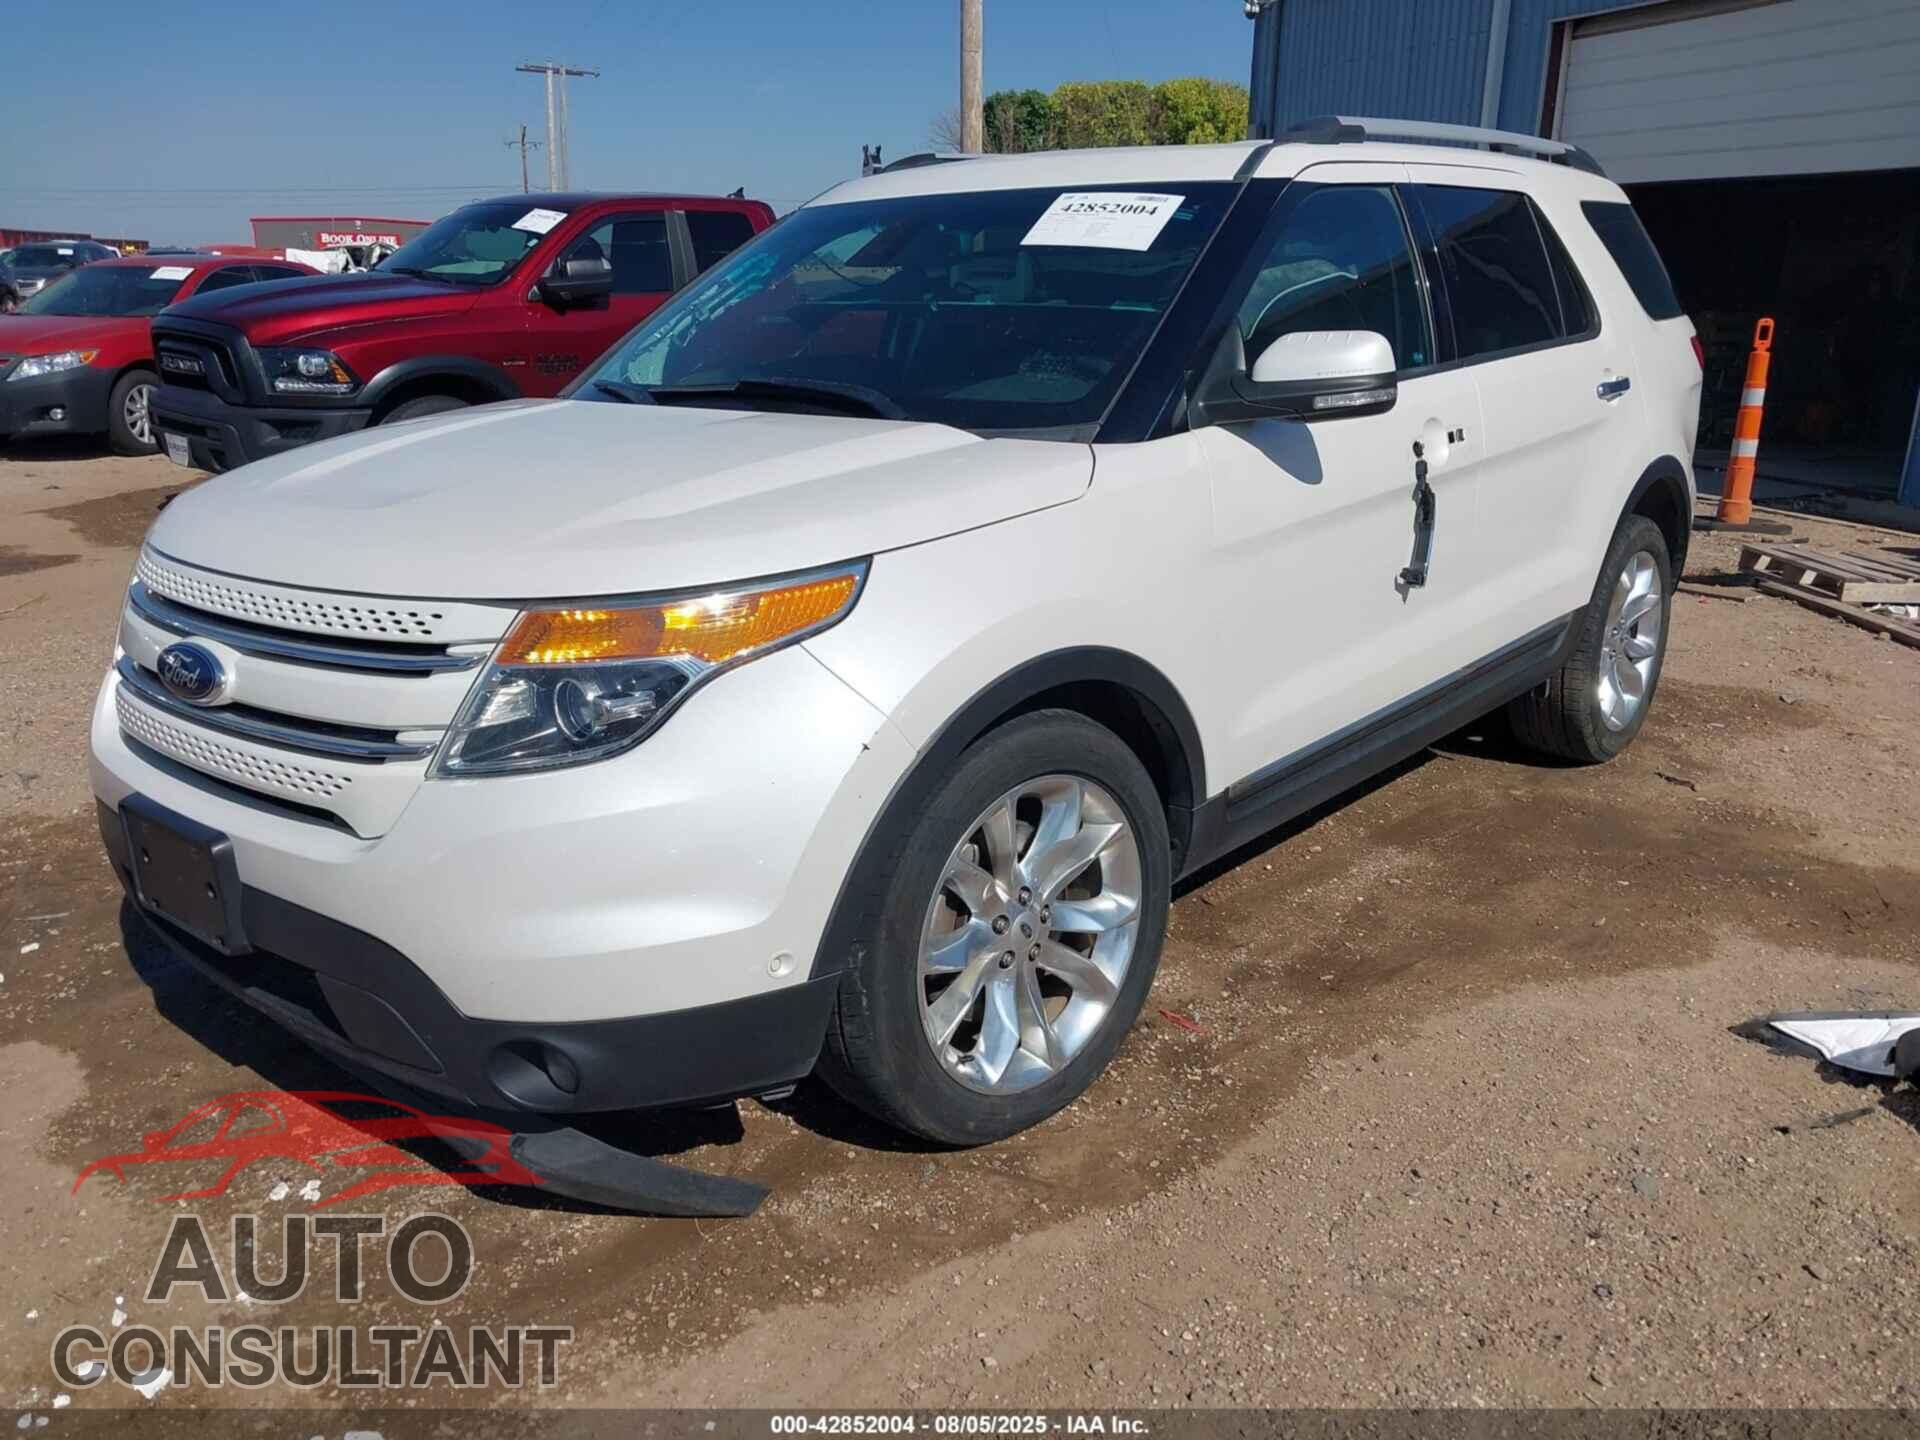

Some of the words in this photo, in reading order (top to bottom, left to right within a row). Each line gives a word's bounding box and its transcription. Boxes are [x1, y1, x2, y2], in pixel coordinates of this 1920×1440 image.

[1061, 202, 1159, 216] 42852004
[320, 232, 354, 244] BOOK
[163, 650, 200, 690] Ford
